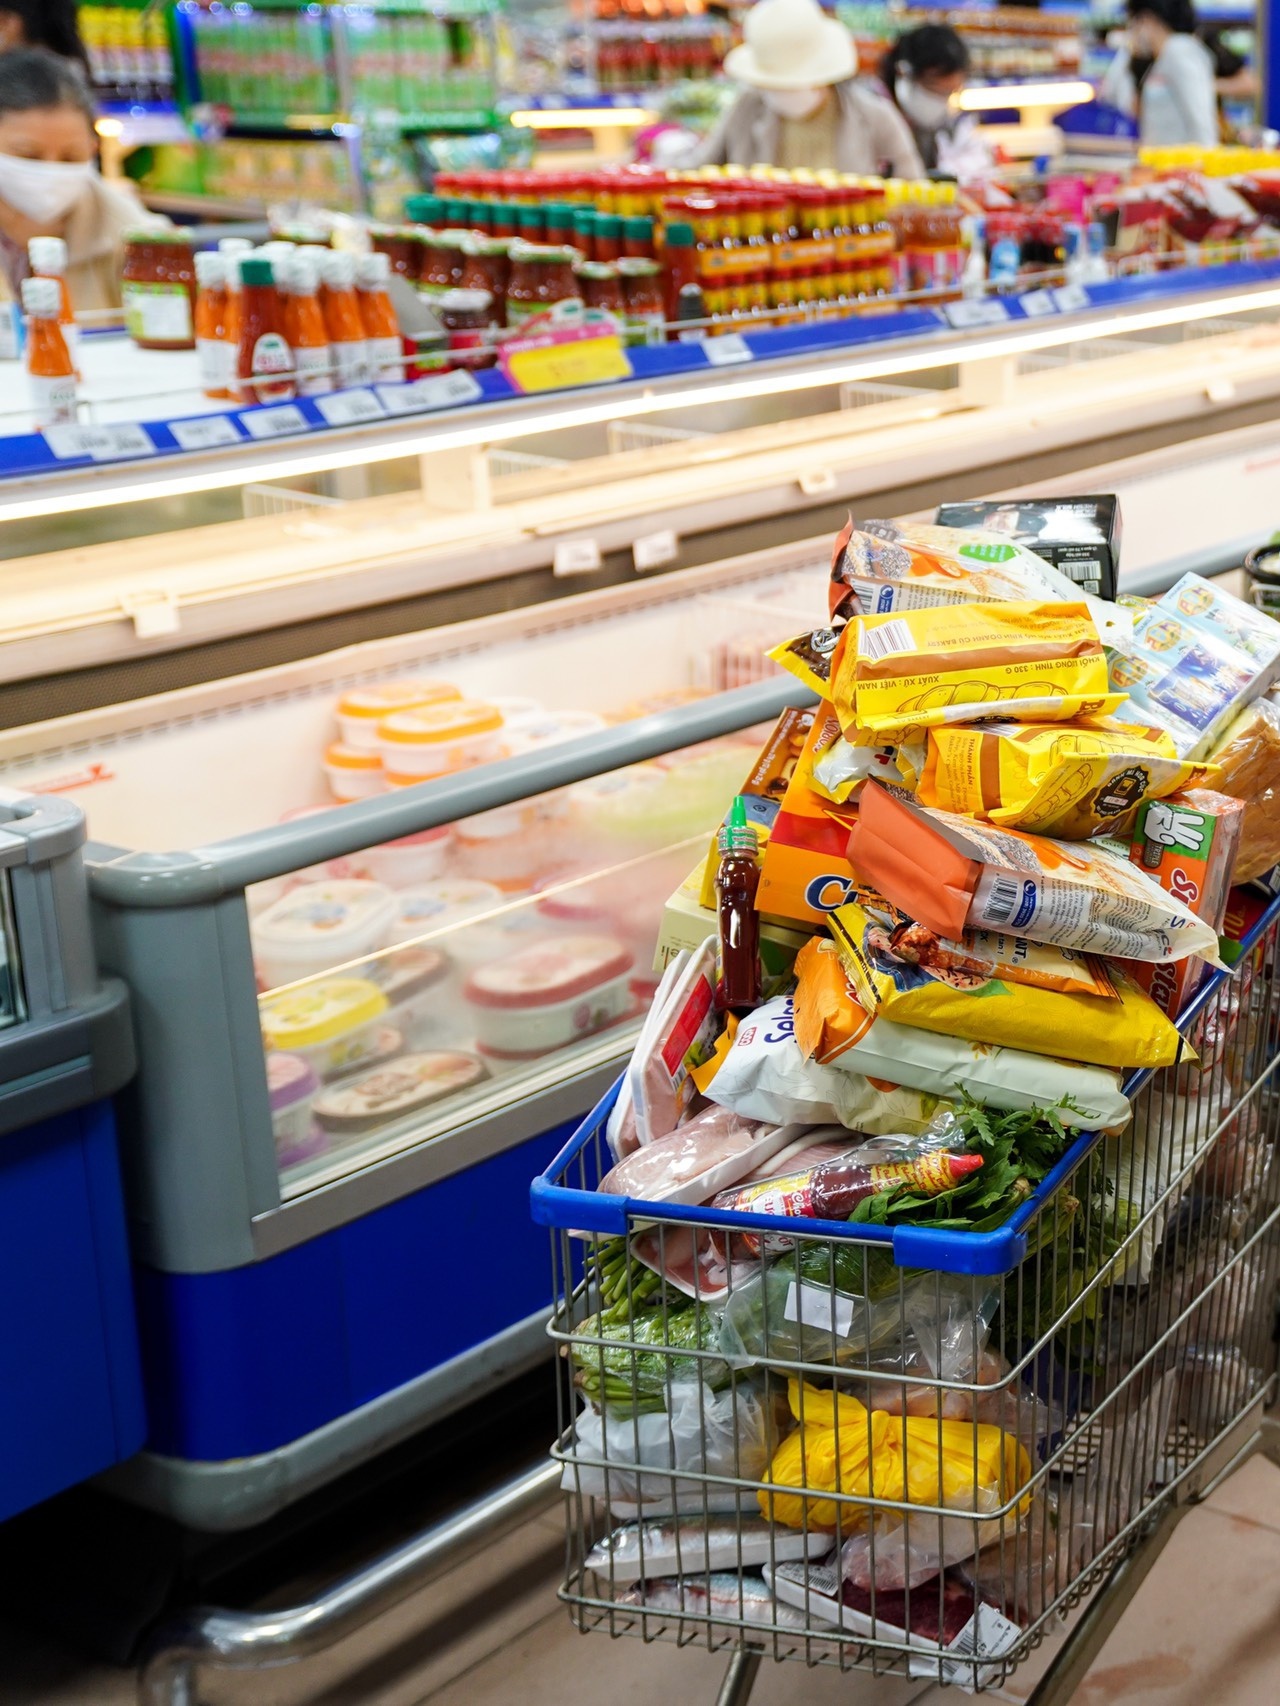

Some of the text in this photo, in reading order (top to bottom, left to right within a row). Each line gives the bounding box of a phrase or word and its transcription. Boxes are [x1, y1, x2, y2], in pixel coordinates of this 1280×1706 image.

[1014, 665, 1028, 673] 330
[858, 682, 877, 690] NAM
[880, 679, 896, 690] VIỆT
[918, 675, 939, 686] XUẤT
[660, 945, 678, 970] eli
